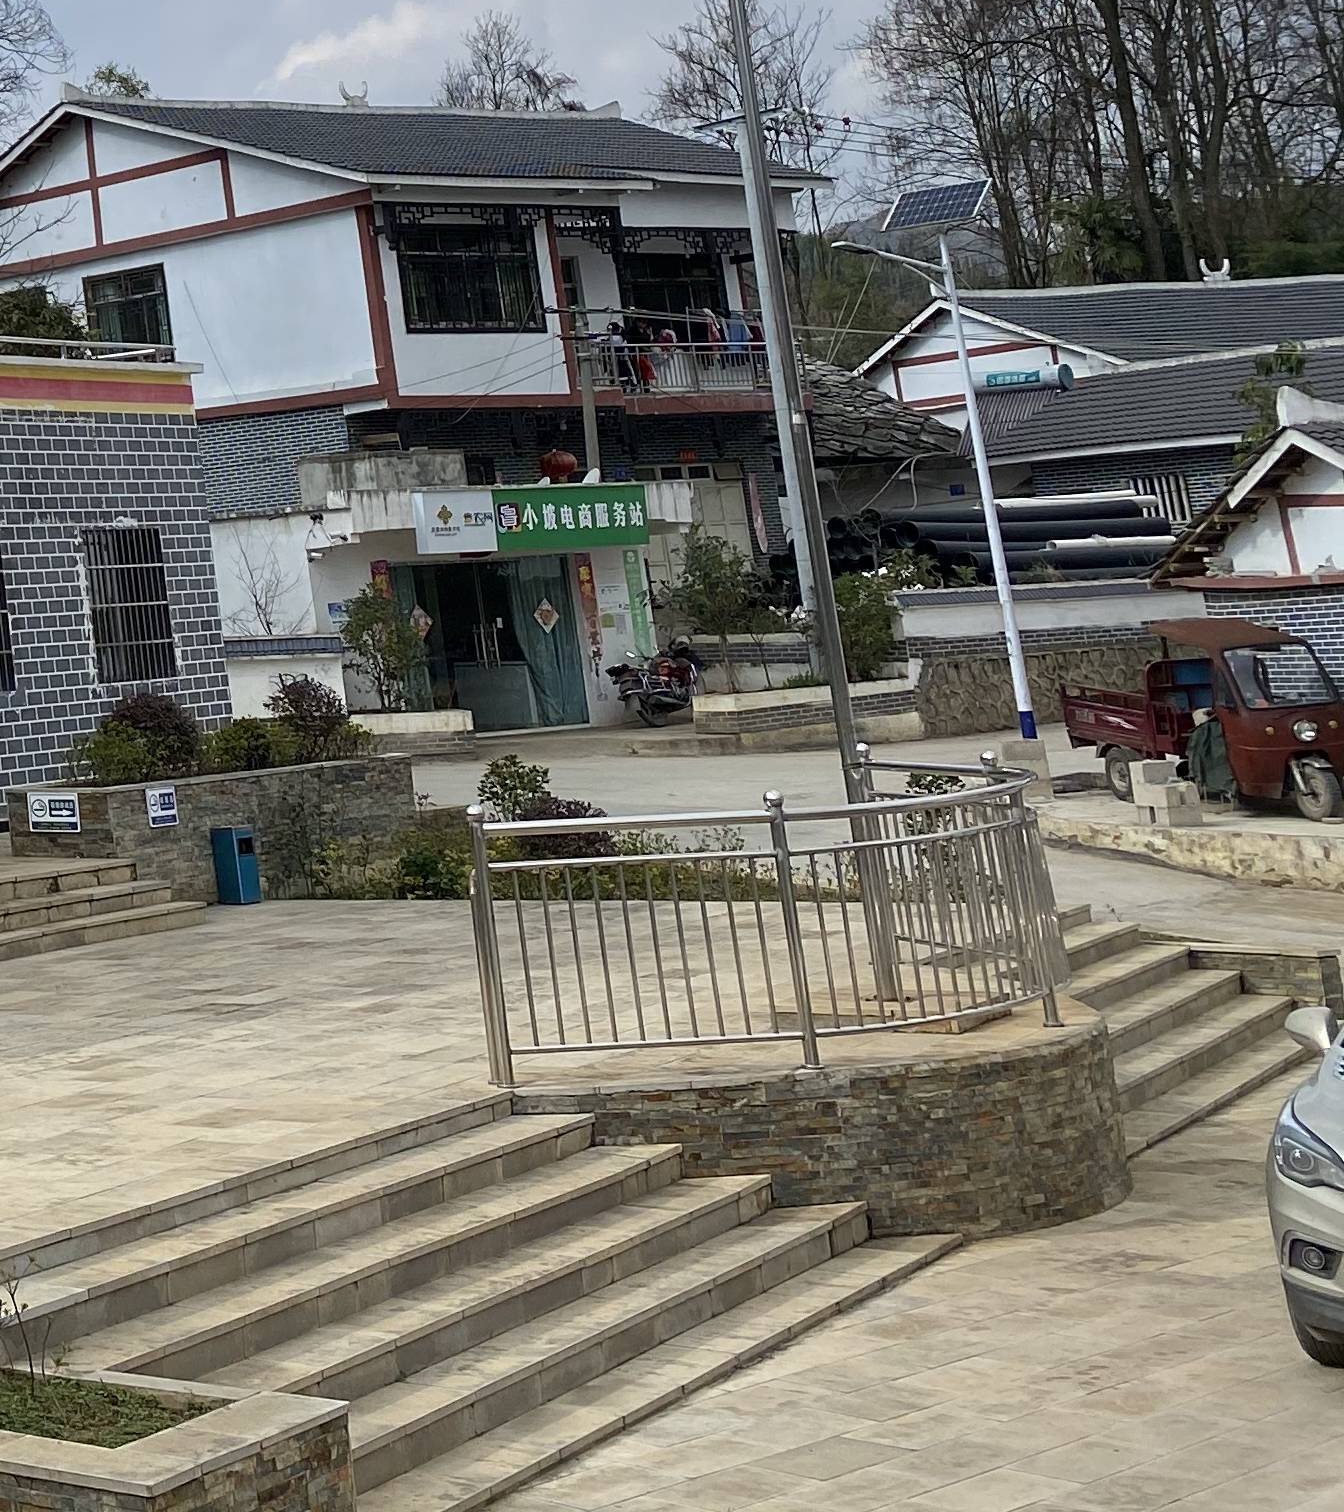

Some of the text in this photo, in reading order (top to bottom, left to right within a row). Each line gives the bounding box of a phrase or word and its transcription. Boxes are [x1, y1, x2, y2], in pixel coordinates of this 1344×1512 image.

[522, 501, 644, 531] 小坡电商服务站
